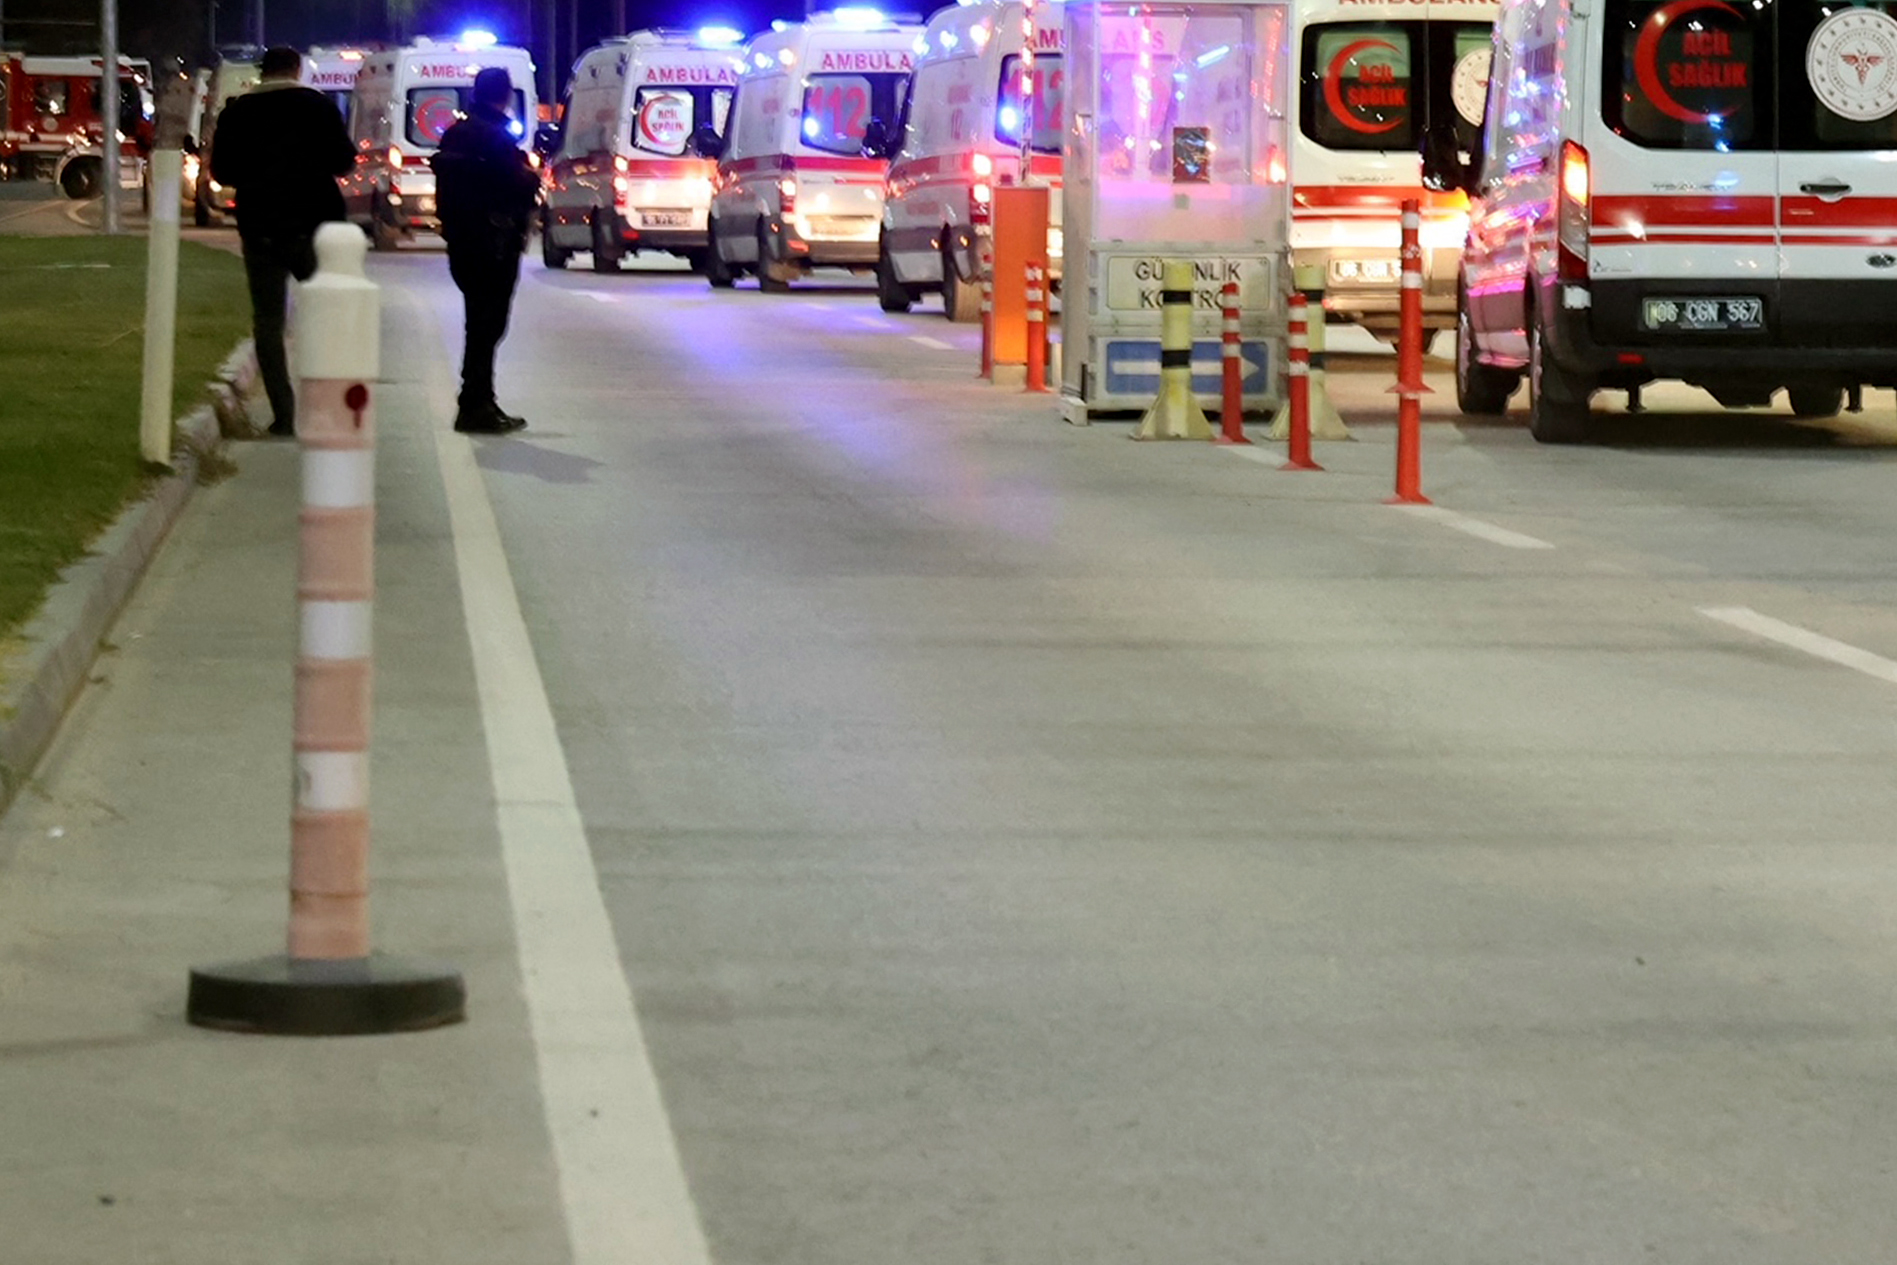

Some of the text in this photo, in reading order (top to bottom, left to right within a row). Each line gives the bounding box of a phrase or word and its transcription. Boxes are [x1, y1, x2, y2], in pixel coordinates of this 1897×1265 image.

[1668, 58, 1747, 86] SAĞLIK
[808, 86, 868, 137] 112
[1135, 256, 1242, 282] GÜNLİK
[1656, 302, 1759, 323] 06 CGN 567
